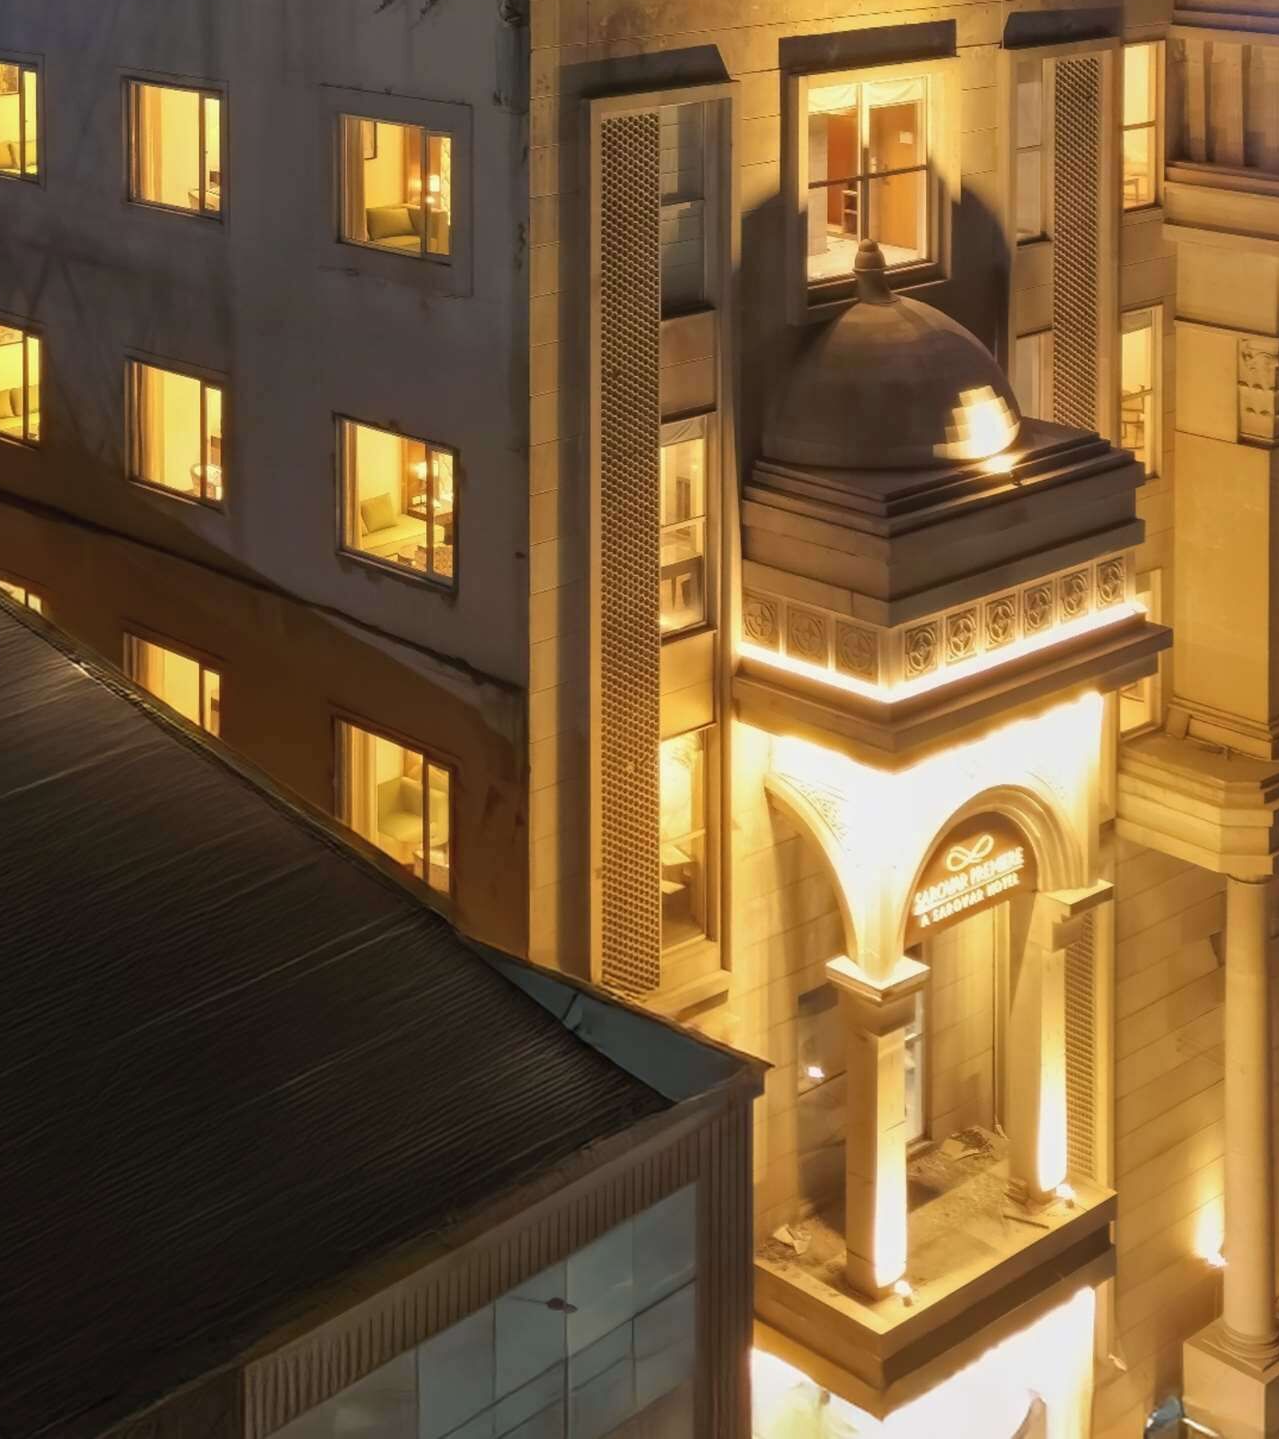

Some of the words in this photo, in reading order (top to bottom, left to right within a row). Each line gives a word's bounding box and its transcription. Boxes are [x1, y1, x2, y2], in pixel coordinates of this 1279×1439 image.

[914, 872, 970, 906] SAROVAR
[970, 846, 1025, 886] PREMIERE
[920, 913, 931, 928] A
[932, 889, 985, 922] SAROVAR
[987, 871, 1021, 897] HOTEL
